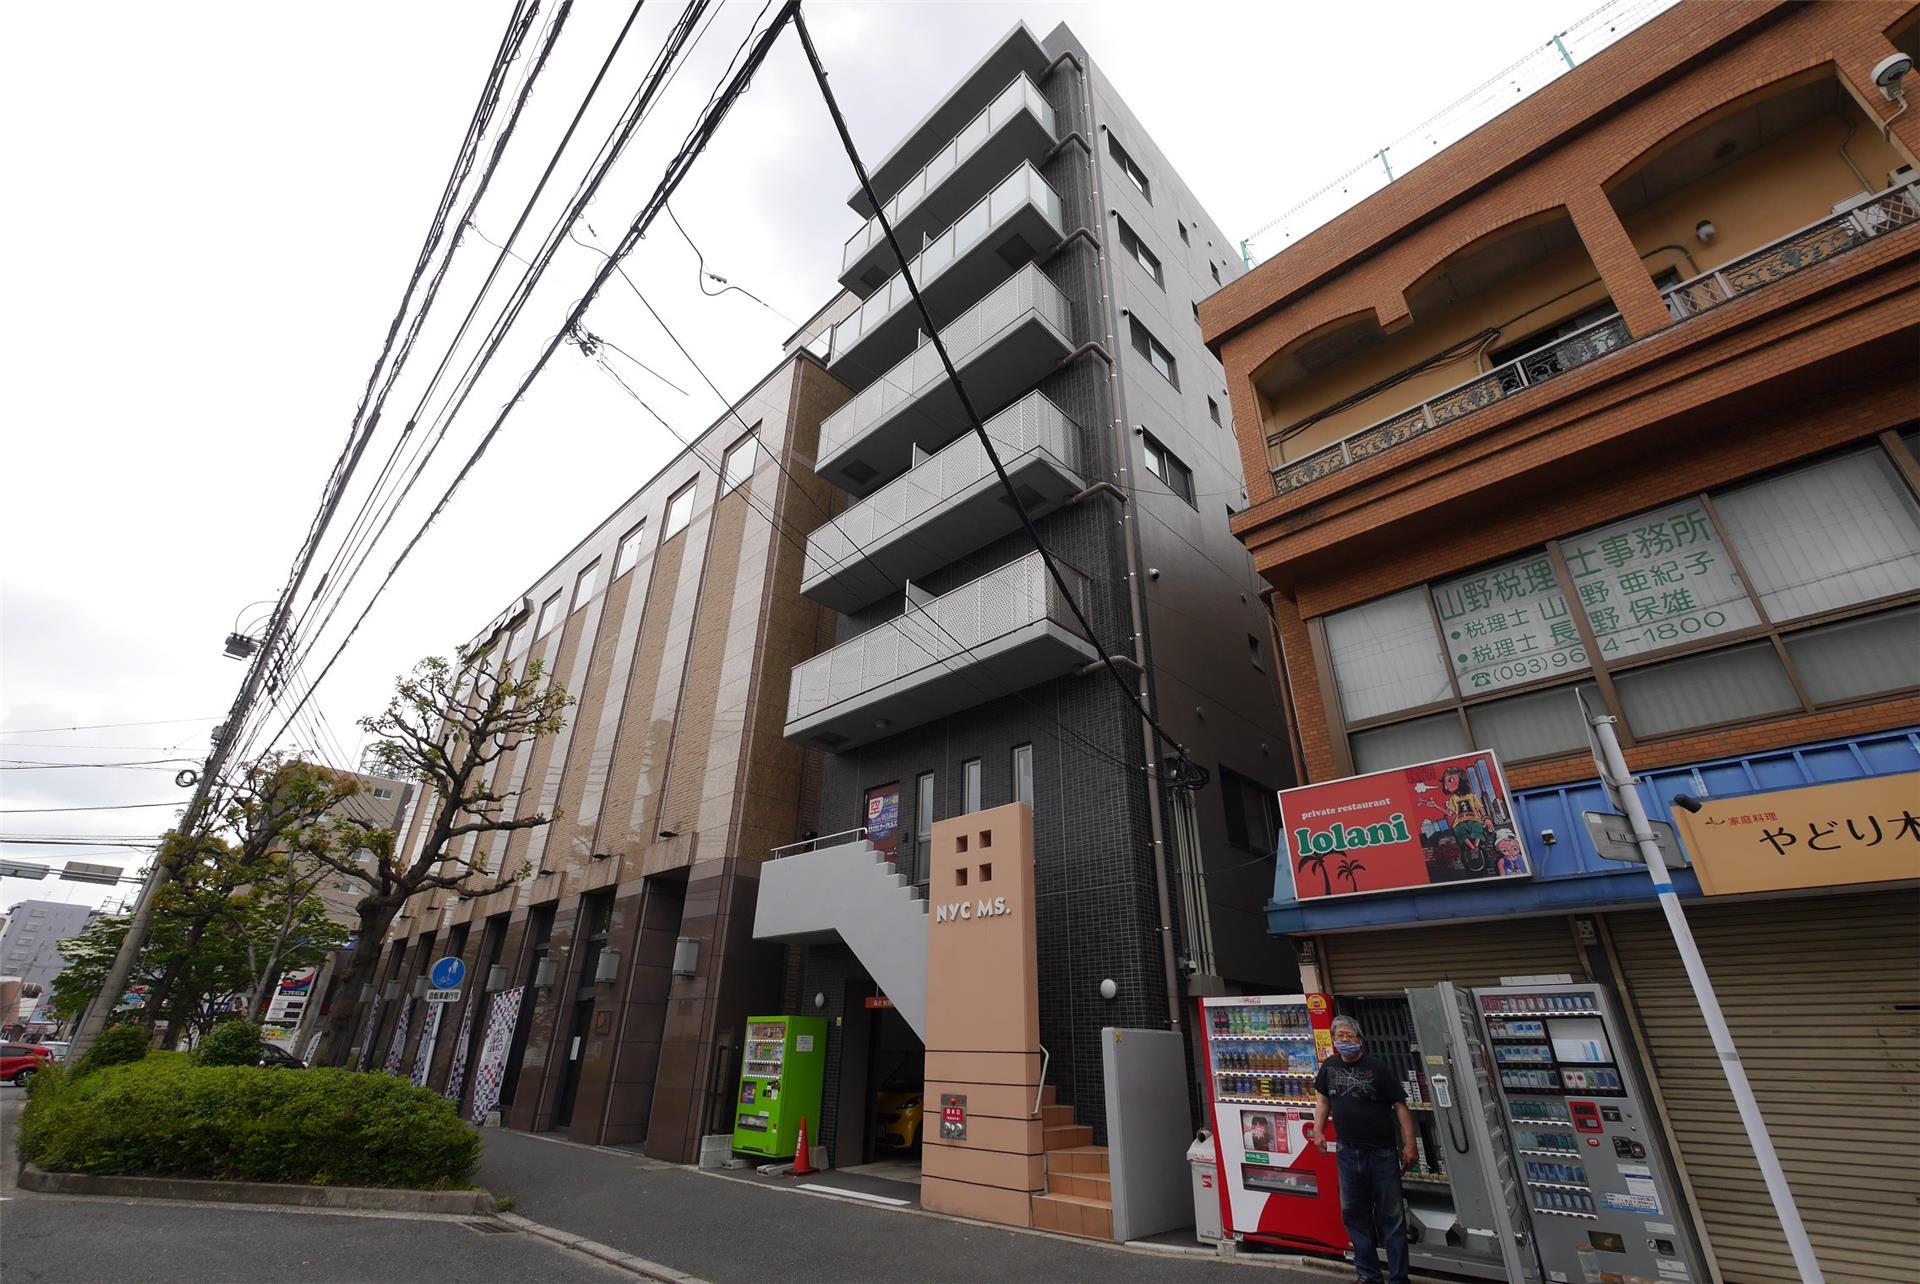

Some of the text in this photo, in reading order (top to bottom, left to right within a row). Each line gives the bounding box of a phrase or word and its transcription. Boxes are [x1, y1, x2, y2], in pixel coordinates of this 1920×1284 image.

[1437, 509, 1711, 620] 山野税理士事務所
[1301, 798, 1391, 820] private restaurant
[1728, 811, 1778, 826] 家庭料理
[1295, 812, 1411, 855] Iolani
[936, 896, 1012, 923] NYC MS.
